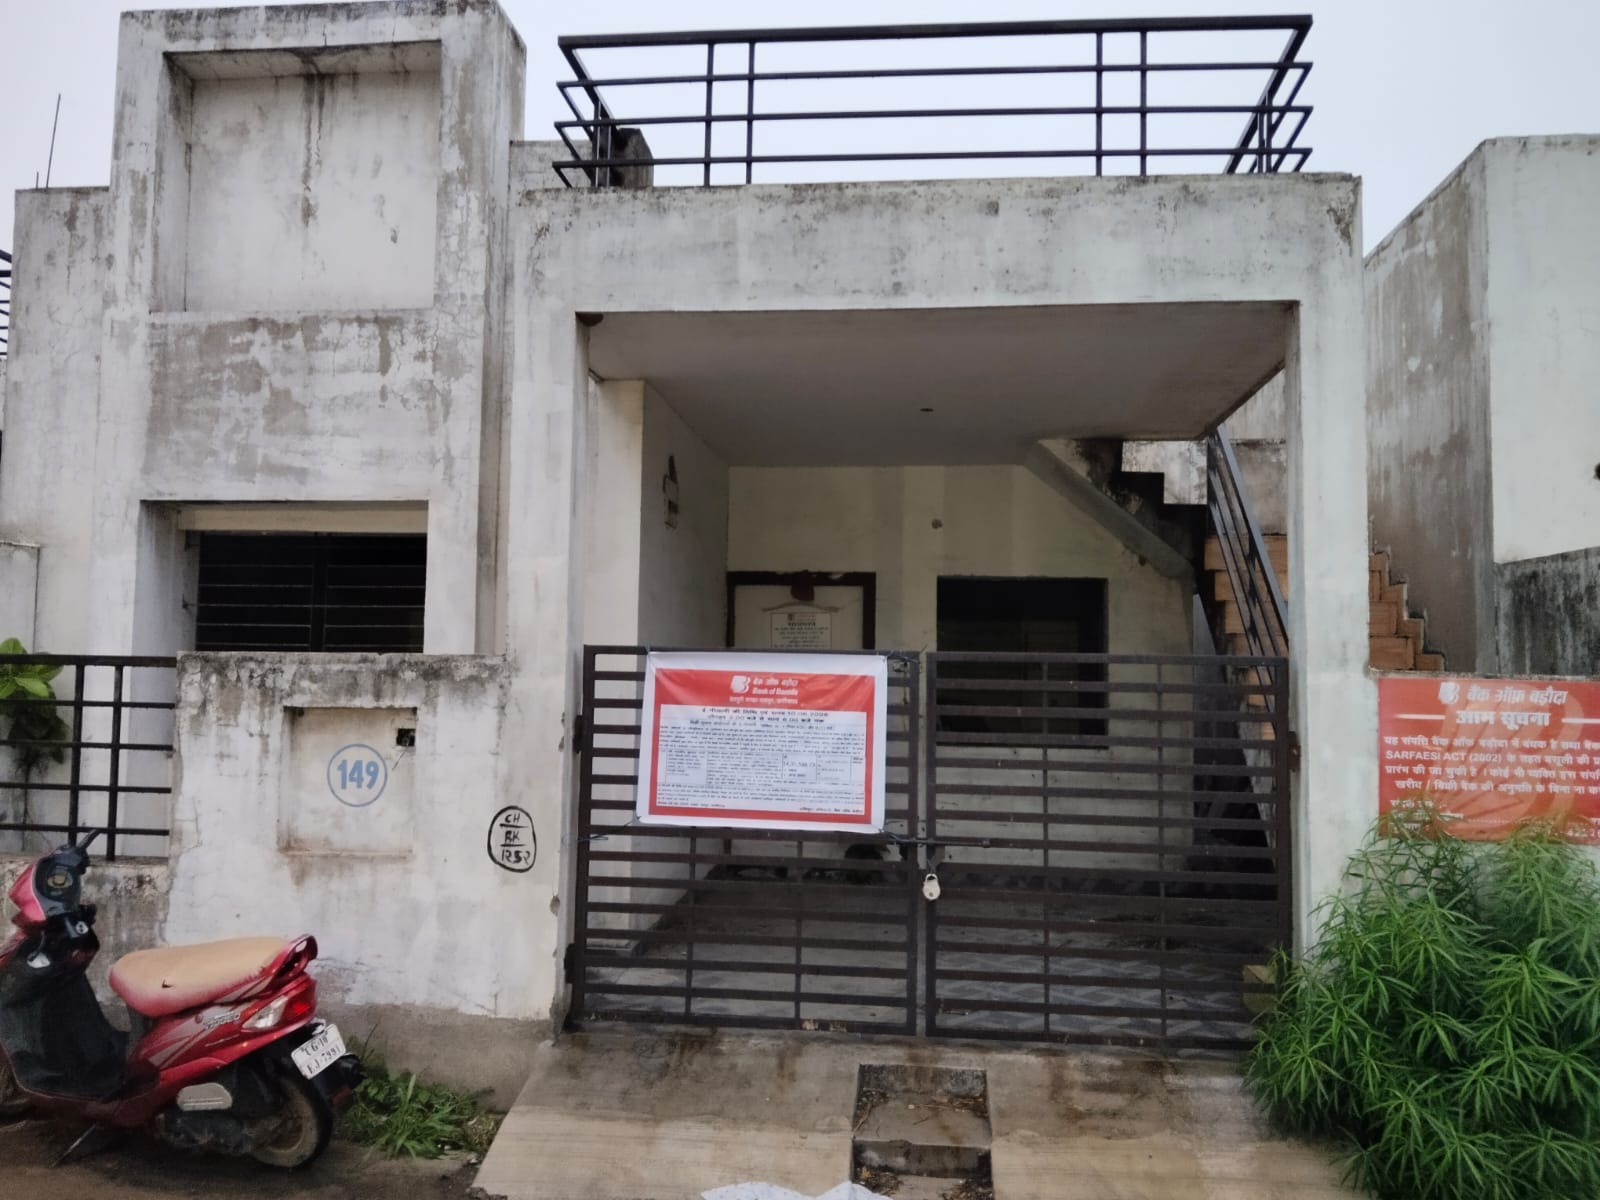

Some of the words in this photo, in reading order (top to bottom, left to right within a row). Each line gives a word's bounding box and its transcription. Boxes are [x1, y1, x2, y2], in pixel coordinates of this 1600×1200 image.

[1500, 711, 1551, 730] सूचना
[1385, 750, 1441, 761] SARFAESI
[1443, 752, 1466, 761] ACT
[1468, 752, 1502, 764] (2002)
[337, 760, 380, 790] 149
[505, 813, 521, 824] CH
